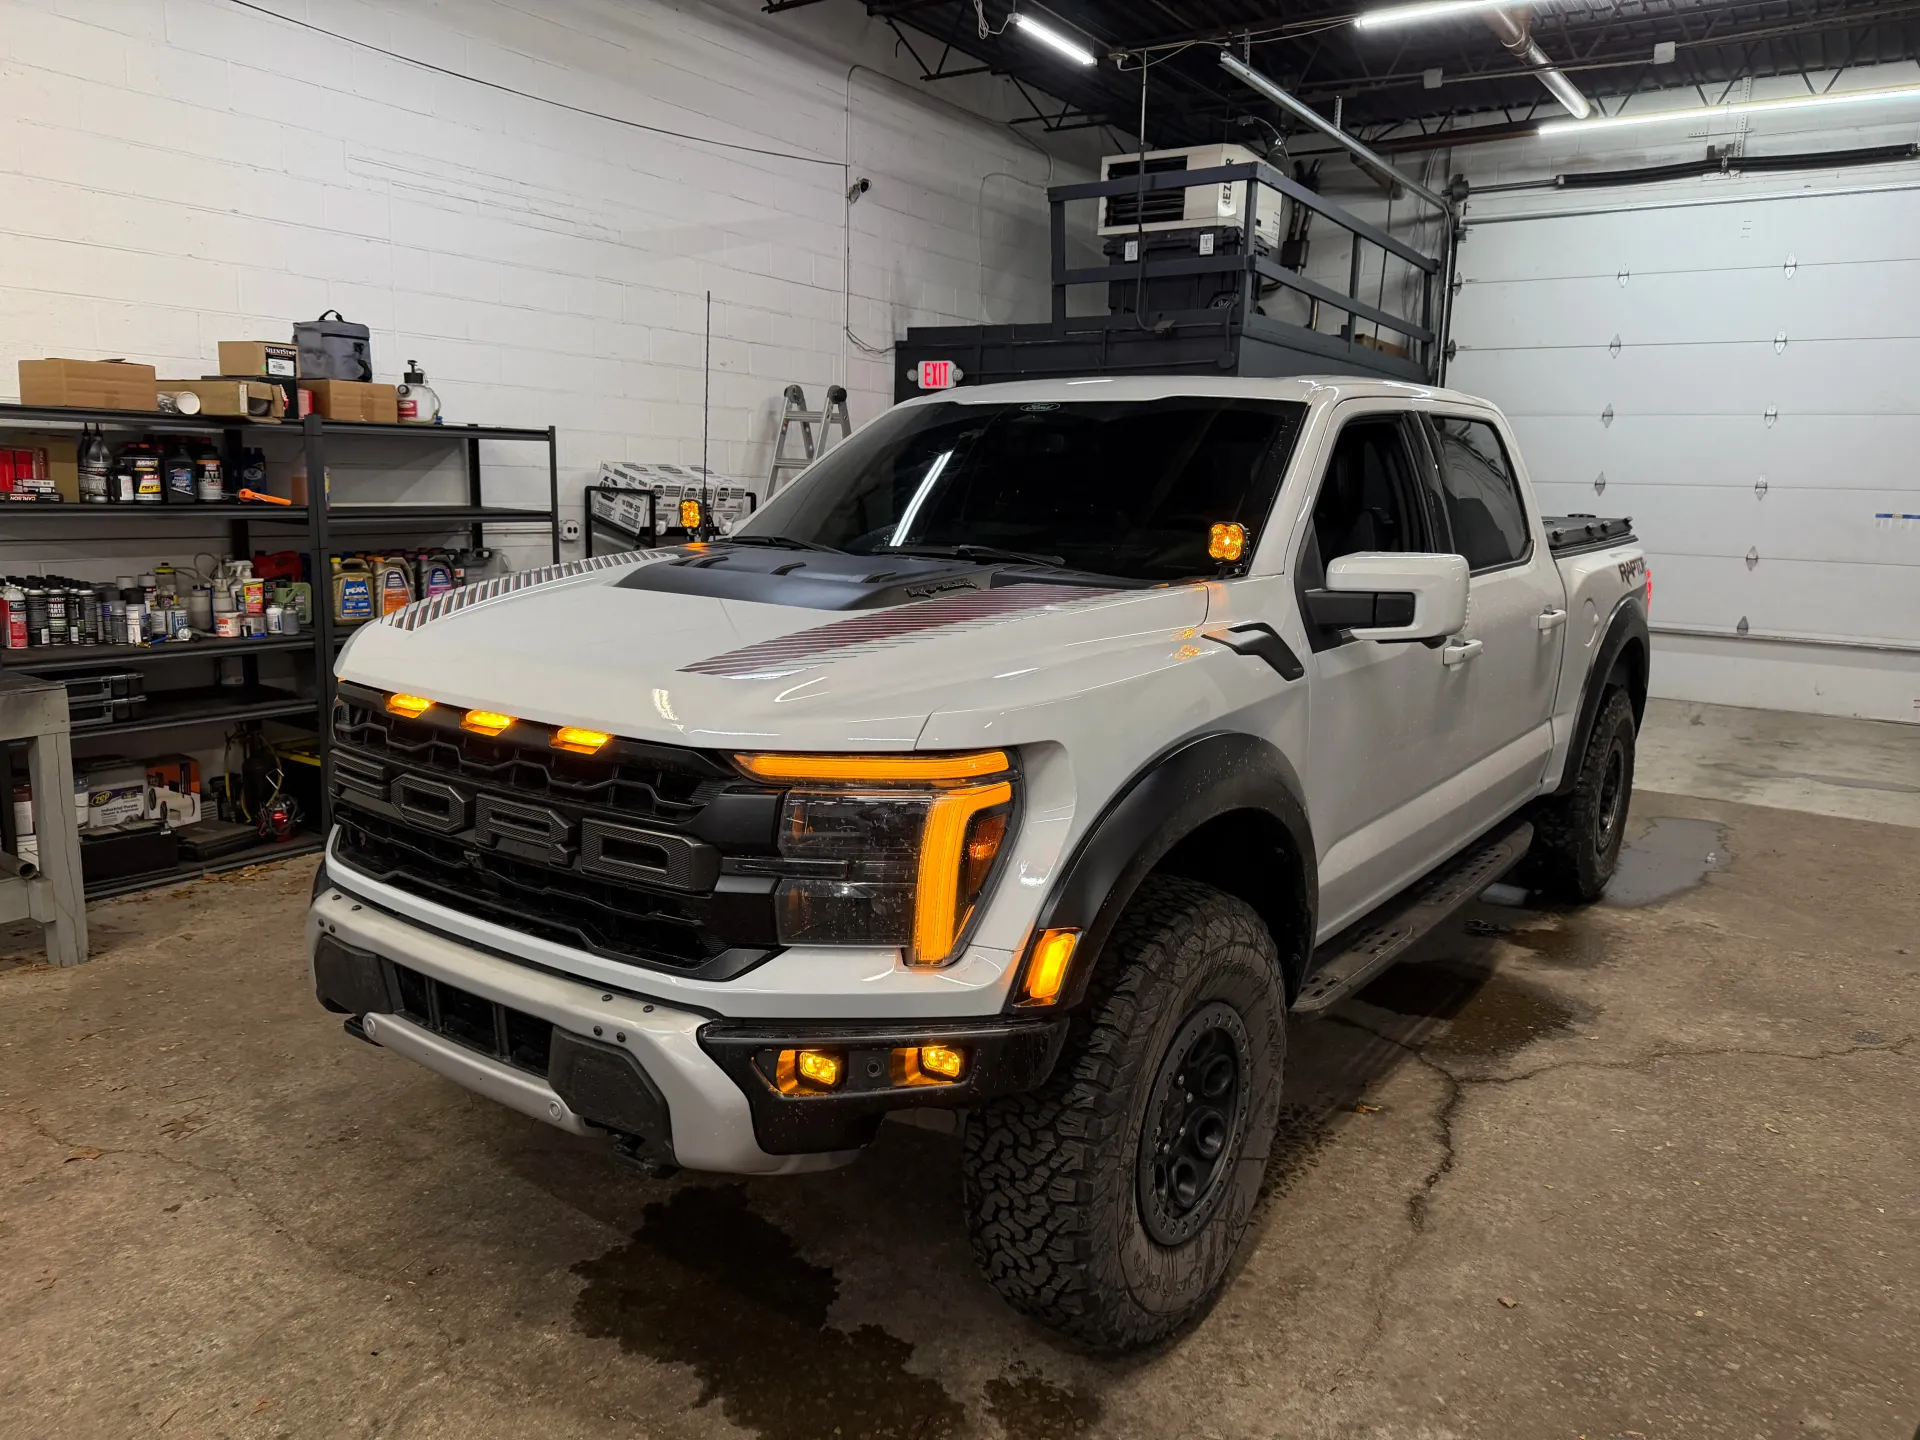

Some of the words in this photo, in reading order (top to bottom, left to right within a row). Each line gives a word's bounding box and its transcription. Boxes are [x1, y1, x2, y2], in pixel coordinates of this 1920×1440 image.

[1222, 157, 1234, 208] REZR
[924, 362, 949, 387] EXIT
[328, 747, 720, 896] FORD
